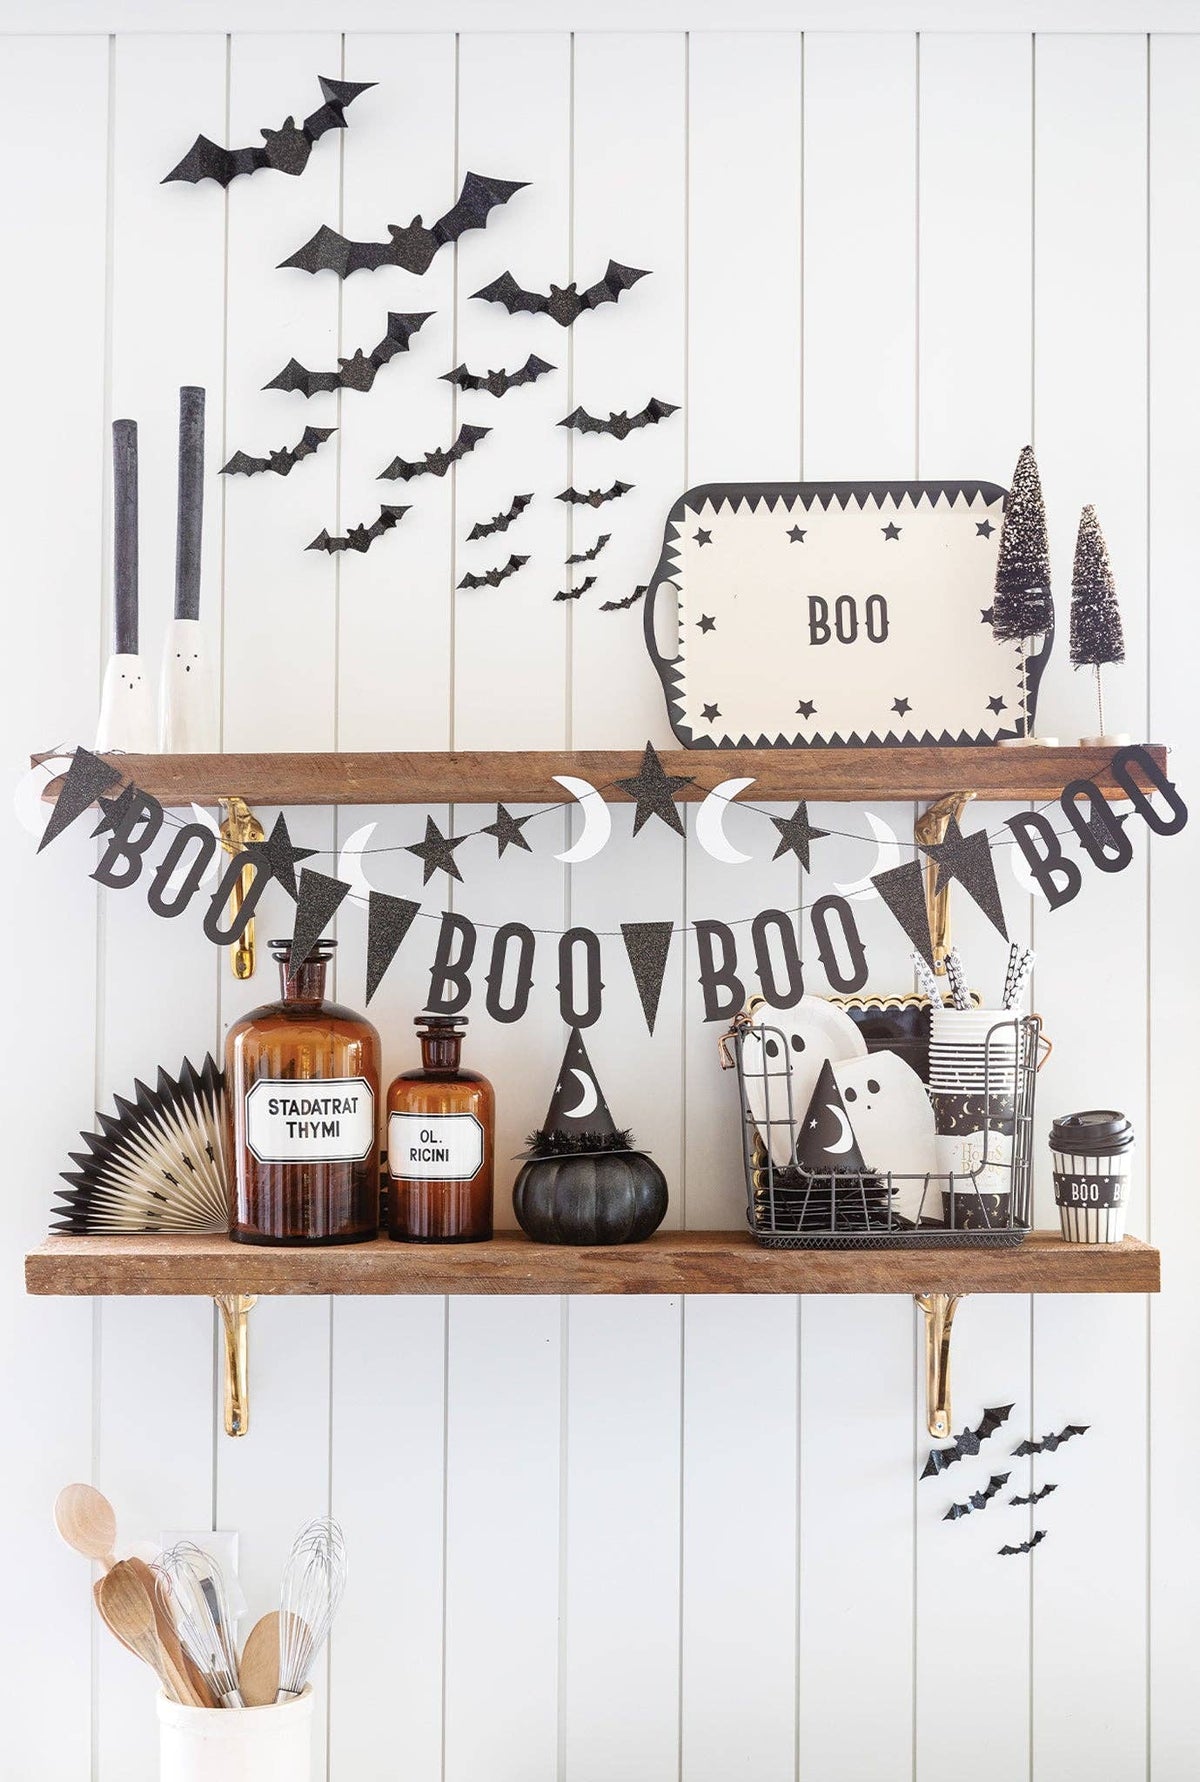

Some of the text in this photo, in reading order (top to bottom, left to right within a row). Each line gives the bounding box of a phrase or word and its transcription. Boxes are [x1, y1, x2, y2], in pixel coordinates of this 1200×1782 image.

[807, 594, 890, 645] BOO
[89, 787, 273, 945] BOO
[422, 911, 605, 1028] BOO
[691, 894, 868, 1023] BOO
[1003, 744, 1188, 912] BOO
[268, 1097, 359, 1116] STADATRAT
[286, 1121, 340, 1139] THYMI
[420, 1129, 442, 1144] OL.
[409, 1148, 450, 1163] RICINI
[1071, 1183, 1099, 1201] BOO
